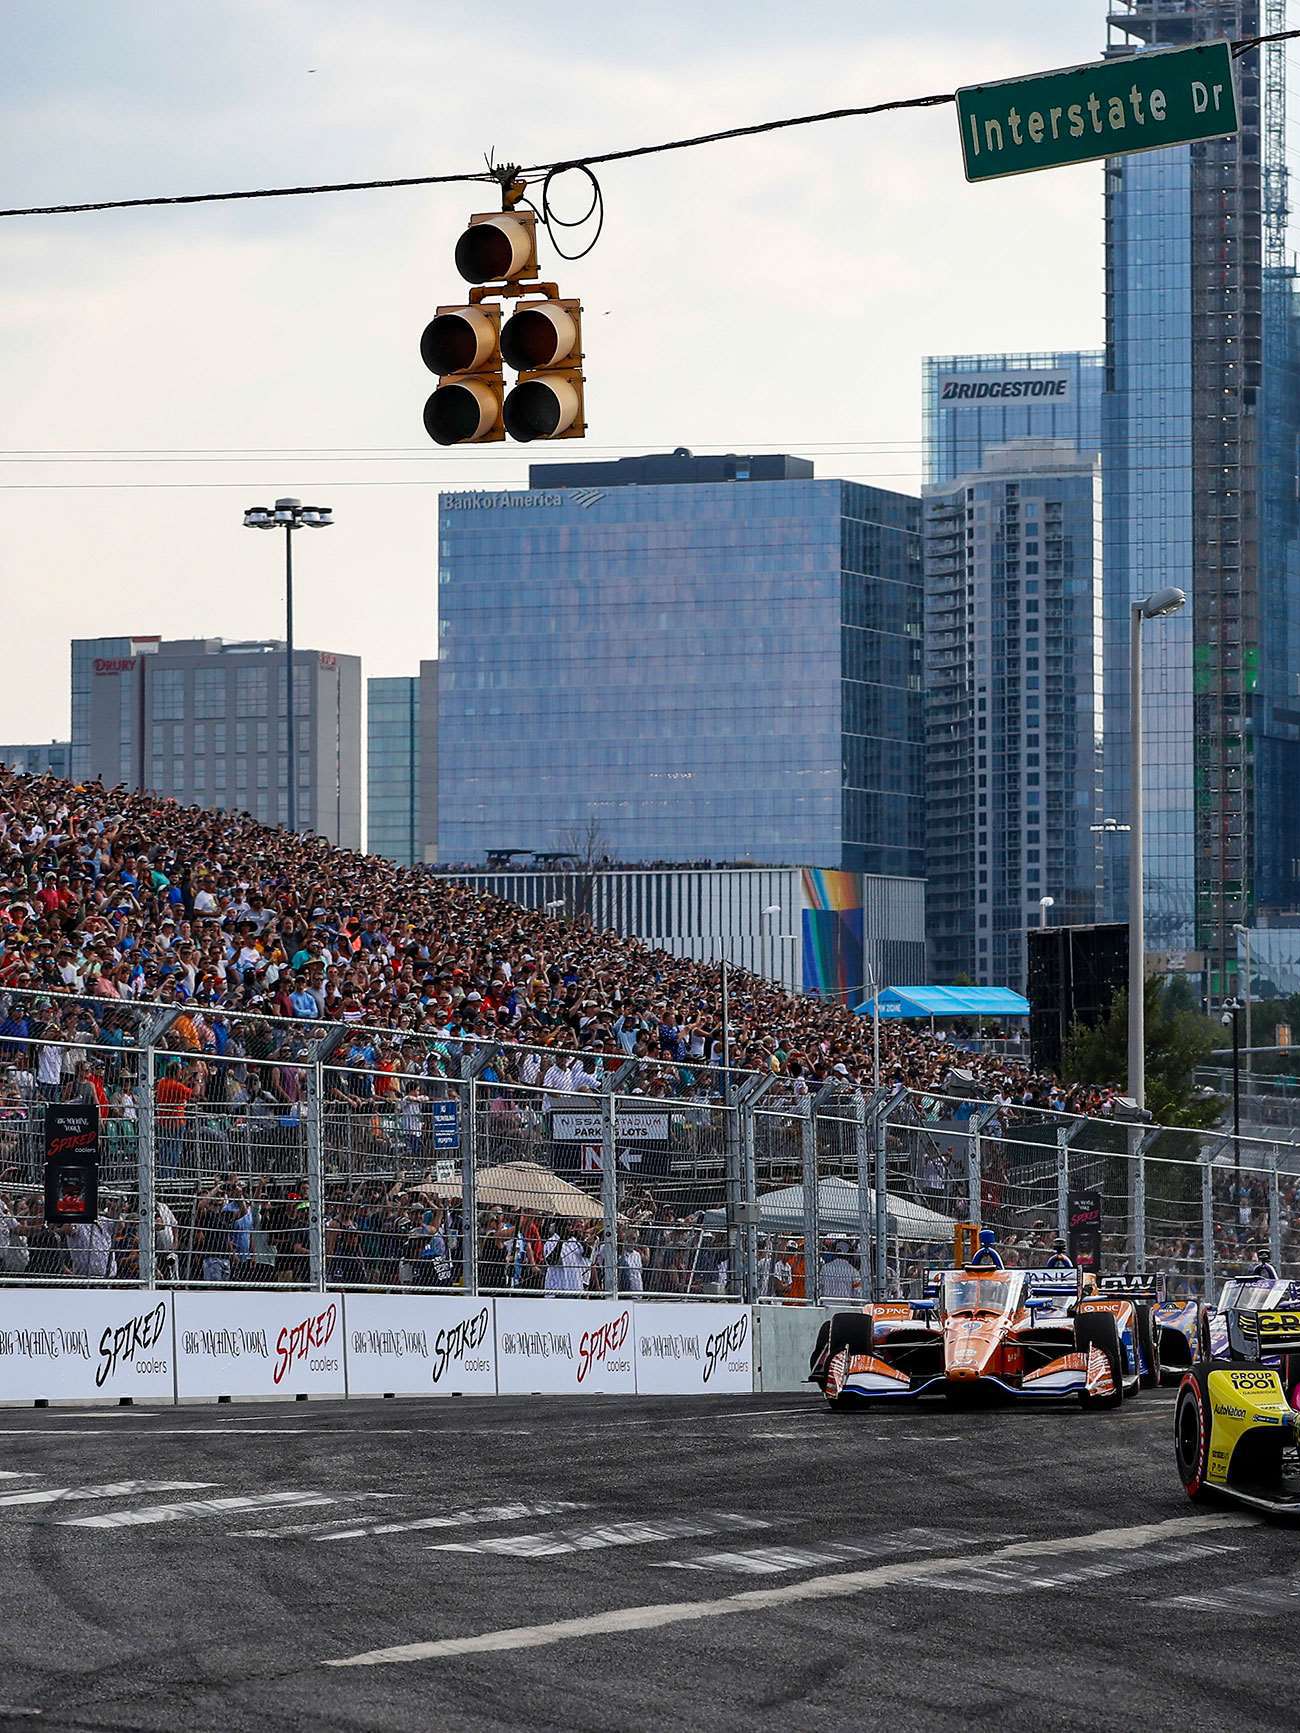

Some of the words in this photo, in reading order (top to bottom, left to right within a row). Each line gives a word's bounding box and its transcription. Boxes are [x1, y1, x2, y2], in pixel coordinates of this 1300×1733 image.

[969, 84, 1167, 156] Interstate
[1191, 81, 1223, 114] Dr
[942, 380, 1067, 399] BRIDGESTONE
[444, 494, 481, 511] Bank
[481, 492, 498, 509] of
[498, 491, 563, 509] America
[94, 657, 136, 671] DRURY
[561, 1118, 601, 1126] NISSA
[575, 1127, 619, 1137] PARKG
[621, 1128, 648, 1136] LOTS
[47, 1131, 97, 1157] SPIKED
[886, 1307, 910, 1315] PNC
[1096, 1304, 1121, 1312] PNC
[14, 1327, 59, 1359] MACHINE
[57, 1327, 92, 1360] VODKA
[96, 1301, 166, 1388] SPIKED
[181, 1329, 199, 1355] BIG
[199, 1328, 241, 1358] MACHINE
[239, 1327, 270, 1358] VODKA
[273, 1303, 337, 1385] SPIKED
[351, 1329, 367, 1354] BIG
[367, 1328, 403, 1358] MACHINE
[432, 1306, 489, 1383] SPIKED
[576, 1310, 630, 1384] SPIKED
[702, 1313, 748, 1383] SPIKED
[135, 1357, 168, 1374] coolers
[310, 1356, 339, 1372] coolers
[464, 1356, 491, 1372] coolers
[606, 1356, 631, 1373] coolers
[727, 1360, 749, 1372] coolers
[1230, 1372, 1272, 1380] GROUP
[1231, 1379, 1276, 1390] 1001
[1213, 1403, 1247, 1419] AutoNation
